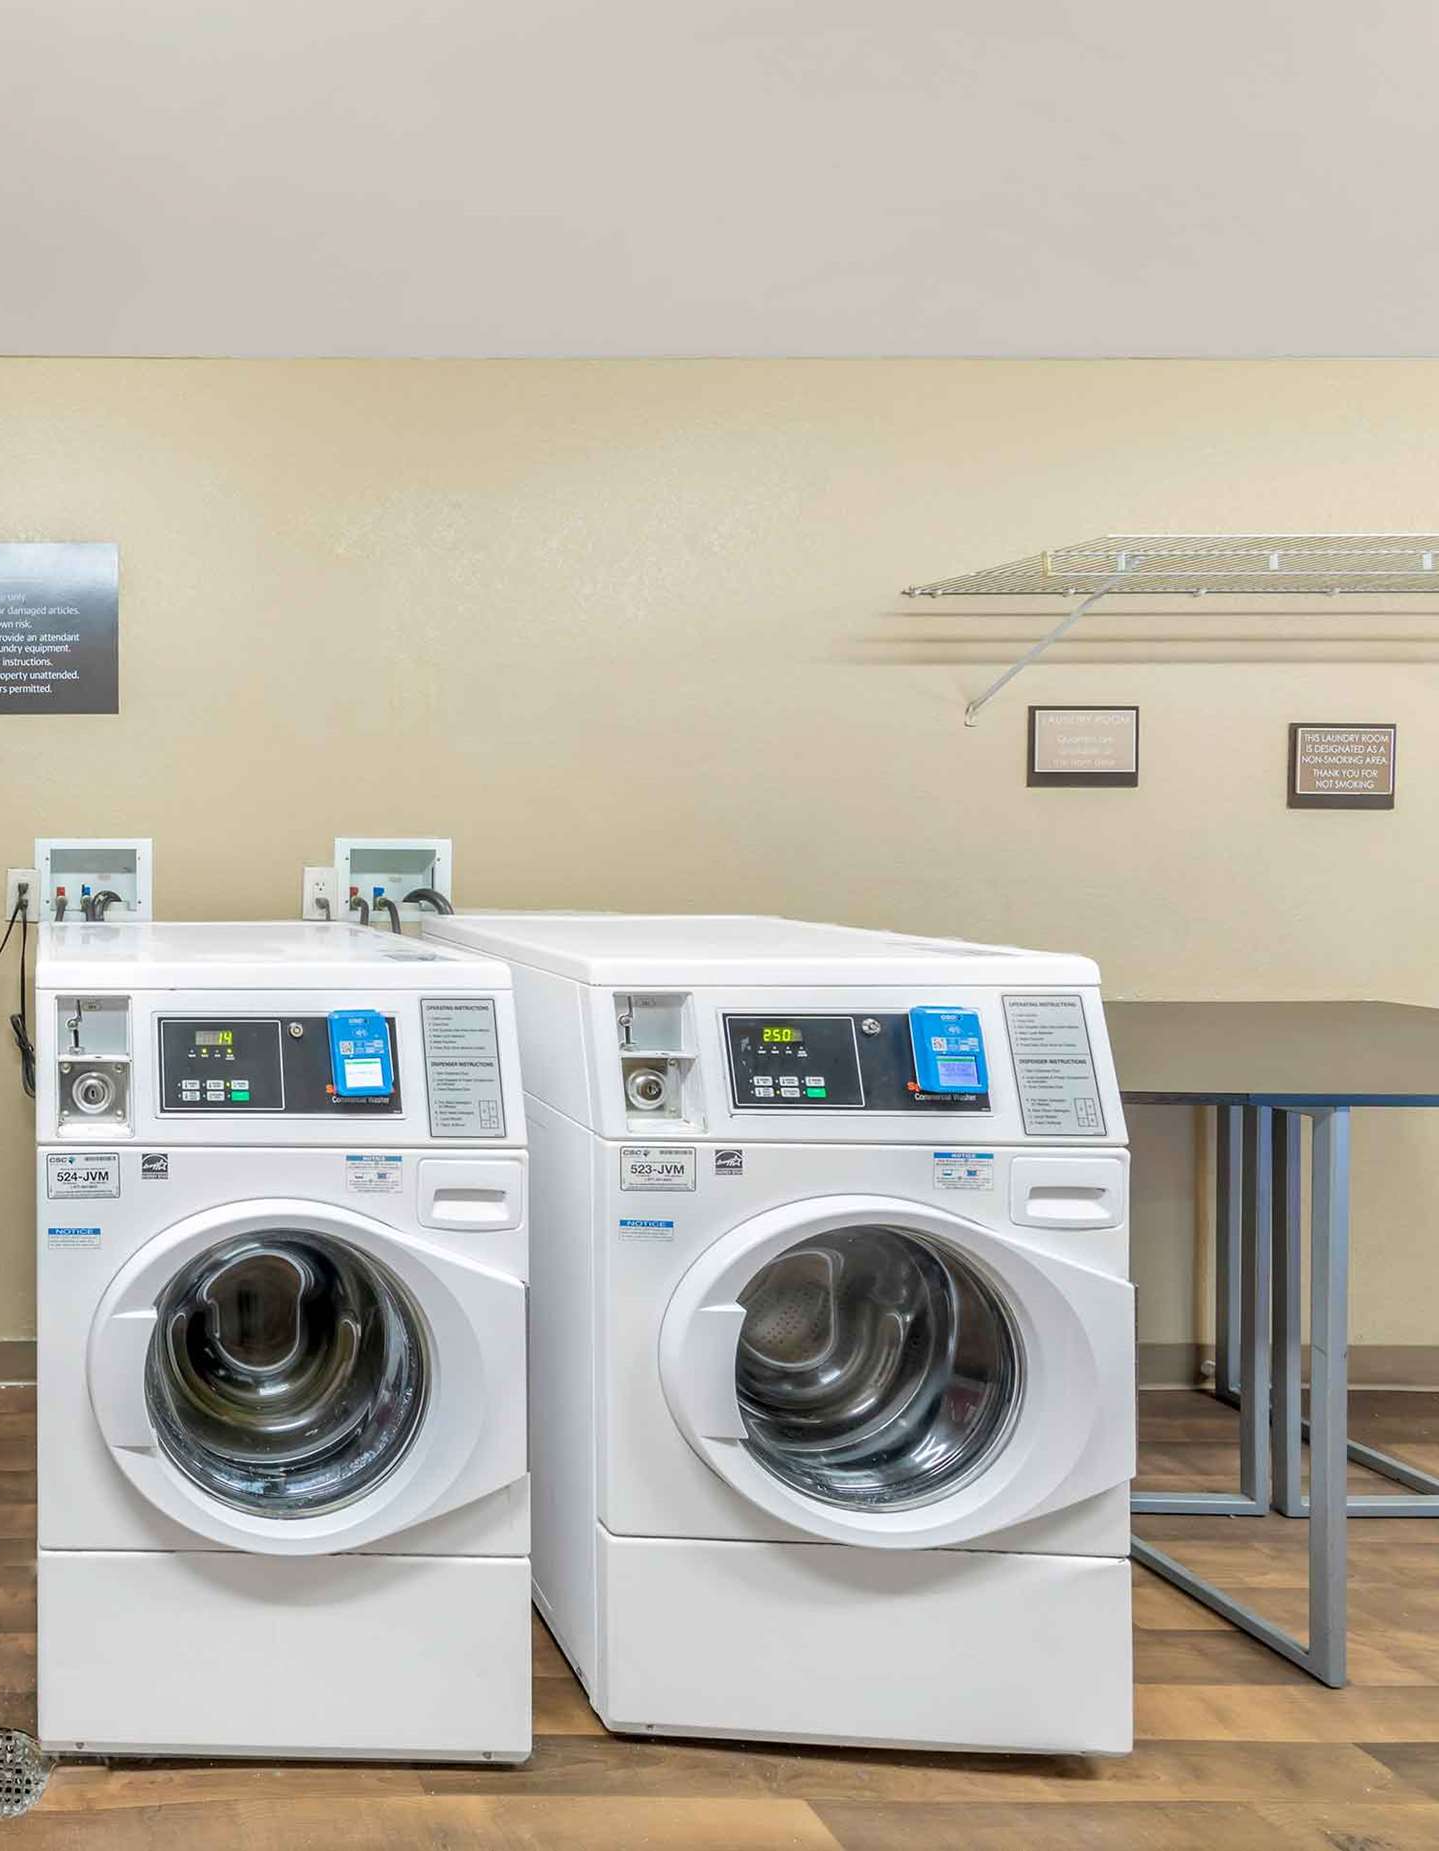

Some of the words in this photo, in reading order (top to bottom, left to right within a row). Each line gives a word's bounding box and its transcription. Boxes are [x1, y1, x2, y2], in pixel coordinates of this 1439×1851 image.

[7, 607, 47, 617] damaged
[48, 607, 80, 615] articles.
[15, 620, 32, 629] risk.
[39, 633, 80, 642] attendant
[24, 645, 71, 654] equipment.
[2, 658, 53, 667] instructions.
[29, 671, 79, 680] unattended.
[9, 684, 52, 695] permitted.
[1304, 733, 1320, 743] THIS
[1321, 733, 1360, 743] LAUNDRY
[1361, 734, 1390, 743] ROOM
[1305, 744, 1313, 752] IS
[1314, 744, 1365, 753] DESIGNATED
[1366, 744, 1377, 753] AS
[1378, 745, 1386, 753] A
[1301, 755, 1363, 764] NON-SMOKING
[1313, 768, 1340, 778] THANK
[1341, 769, 1360, 778] YOU
[1361, 769, 1379, 778] FOR
[1315, 779, 1333, 789] NOT
[1335, 780, 1374, 789] SMOKING
[630, 1164, 685, 1175] 523-JVM
[57, 1171, 110, 1182] 524-JVM
